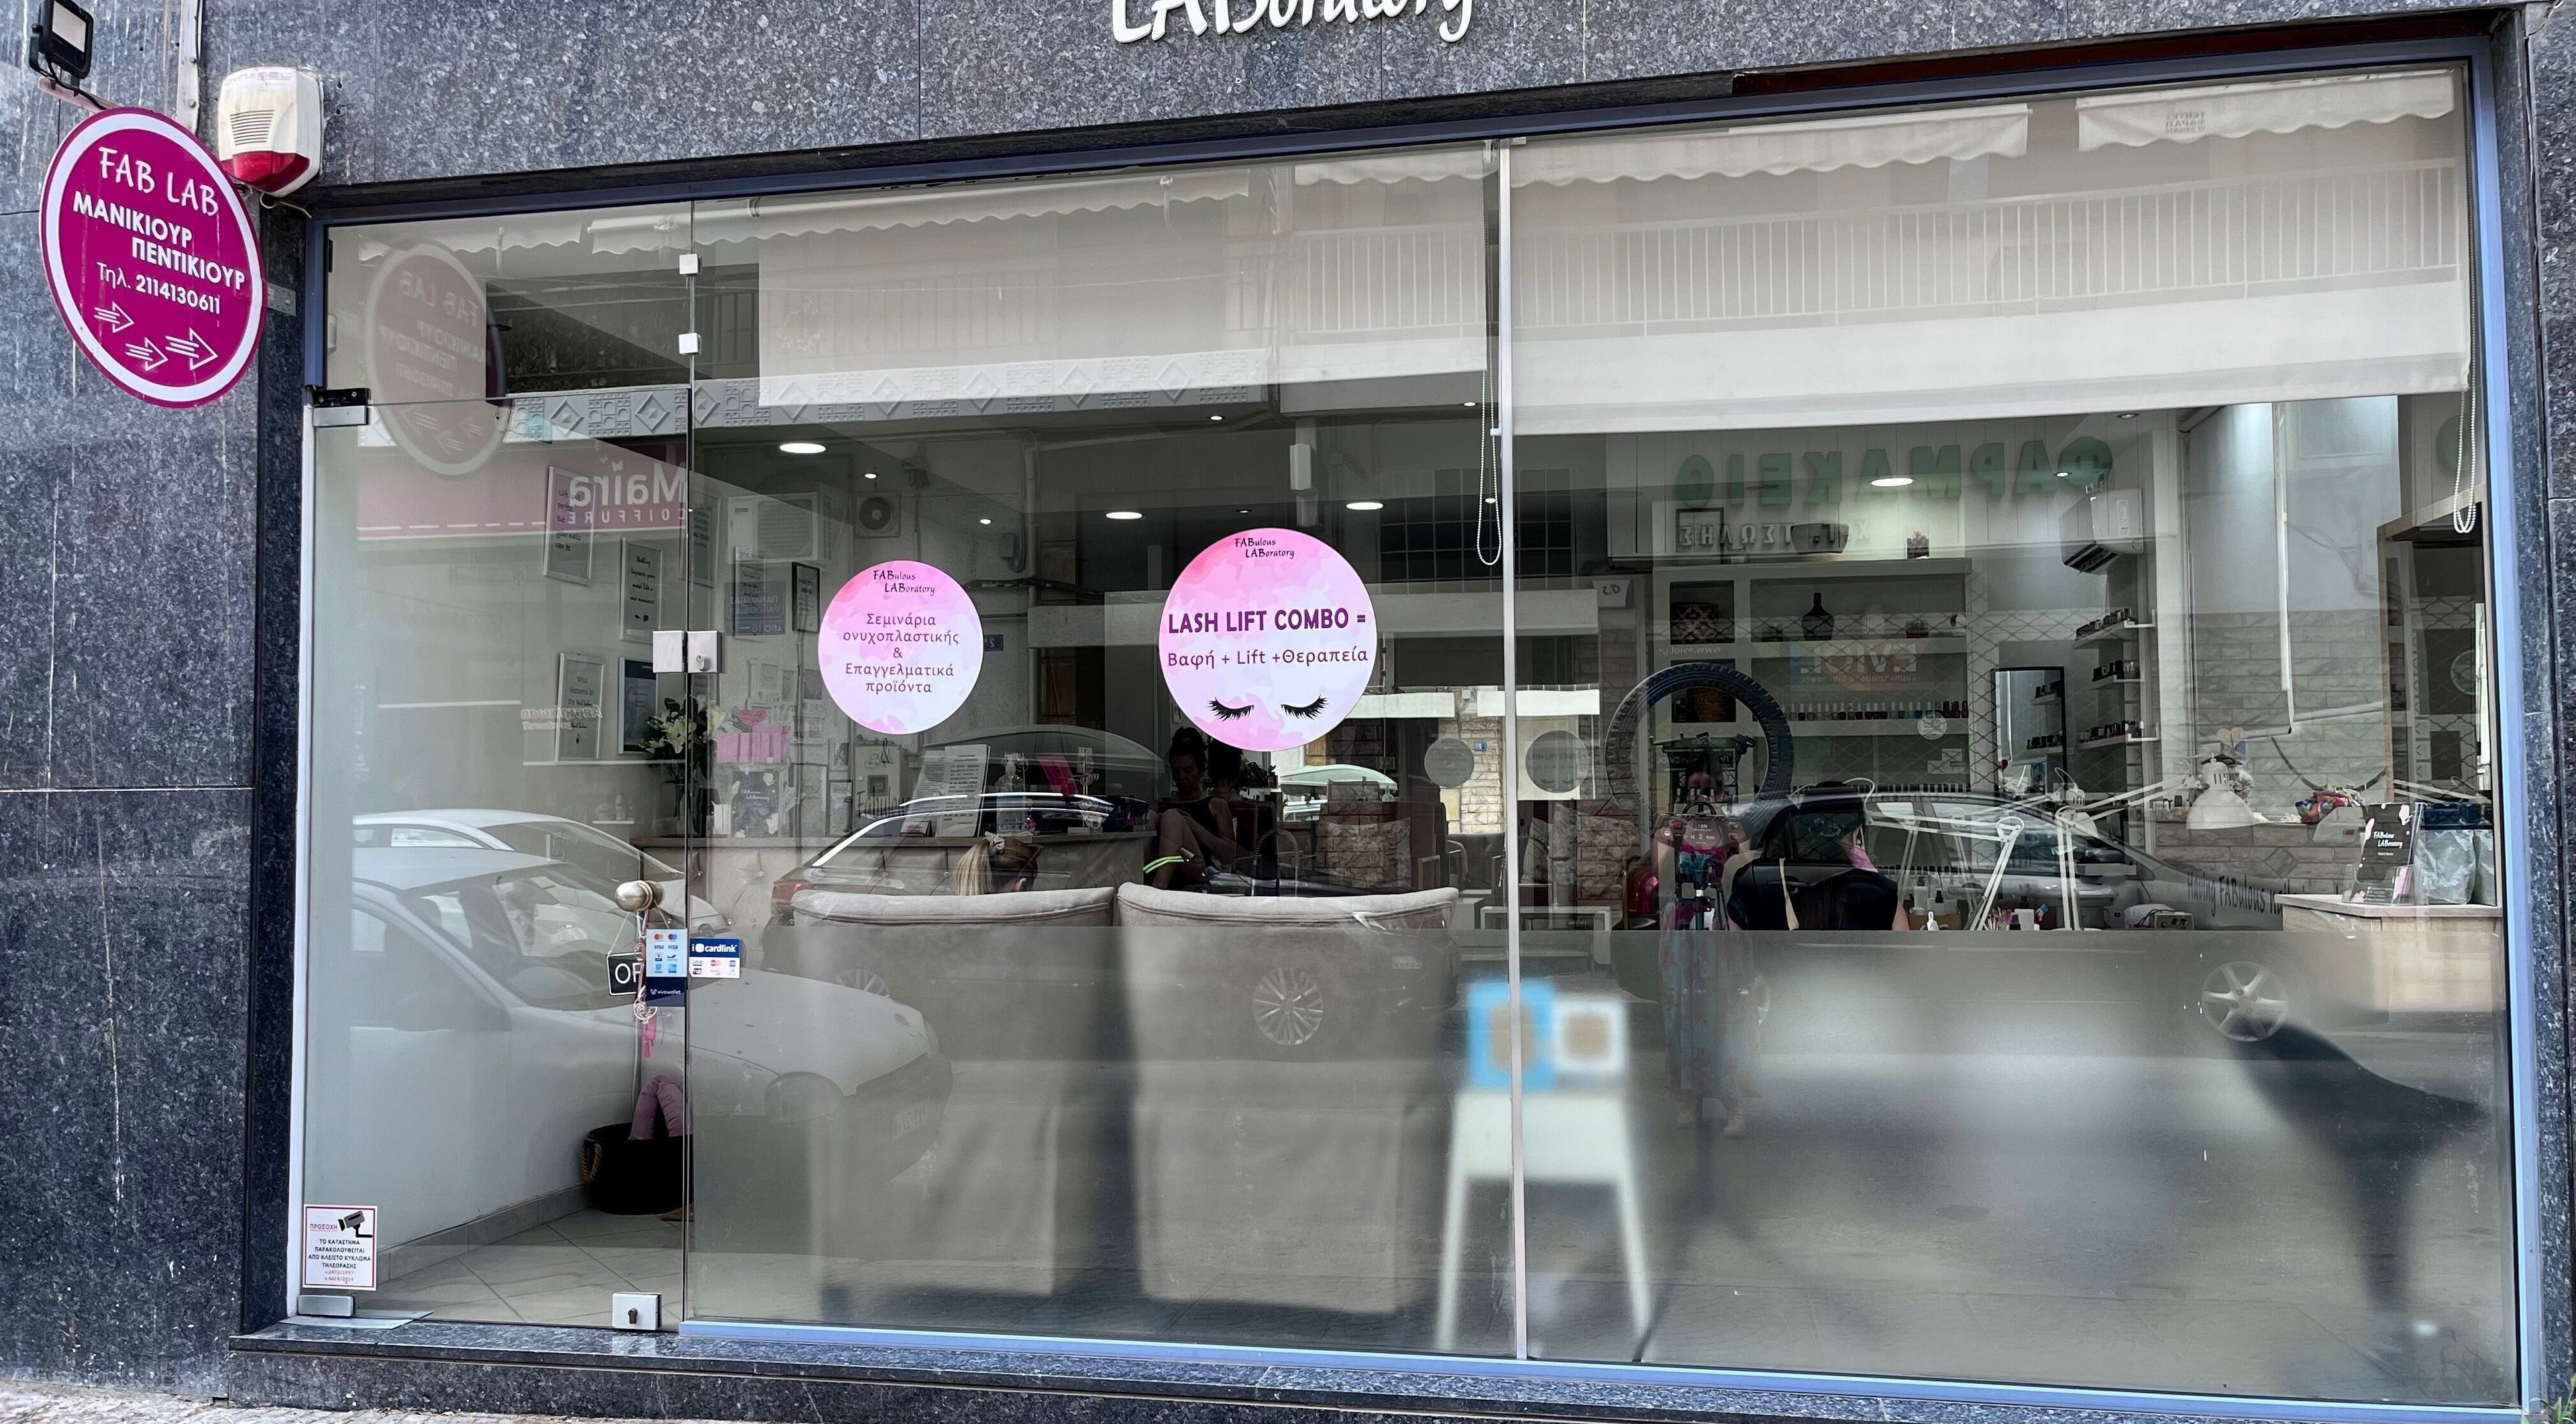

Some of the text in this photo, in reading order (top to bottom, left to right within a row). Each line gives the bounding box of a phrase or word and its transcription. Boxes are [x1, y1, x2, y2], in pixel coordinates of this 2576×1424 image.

[99, 146, 219, 216] FAB LAB
[73, 190, 193, 249] ΜΑΝΙΚΙΟΥΡ
[132, 237, 246, 290] ΠΕΝΤΙΚΙΟΥΡ
[97, 262, 220, 314] Τηλ. 2114130611
[1235, 537, 1276, 547] FABulous
[1246, 548, 1295, 559] LABoratory
[873, 570, 916, 580] FABulous
[885, 583, 935, 596] LABoratory
[866, 612, 936, 628] Σεμινάρια
[1169, 612, 1218, 633] LASH
[1226, 610, 1267, 632] LIFT
[1275, 608, 1348, 631] COMBO
[843, 631, 959, 645] ονυχοπλαστικής
[893, 648, 903, 658] &
[1168, 650, 1215, 670] Βαφή
[1237, 650, 1266, 665] Lift
[846, 663, 954, 677] Επαγγελματικά
[866, 680, 932, 694] προϊόντα
[2188, 872, 2216, 918] Having
[2218, 873, 2265, 914] FABulous
[705, 944, 736, 952] cardlink
[614, 962, 643, 984] OP
